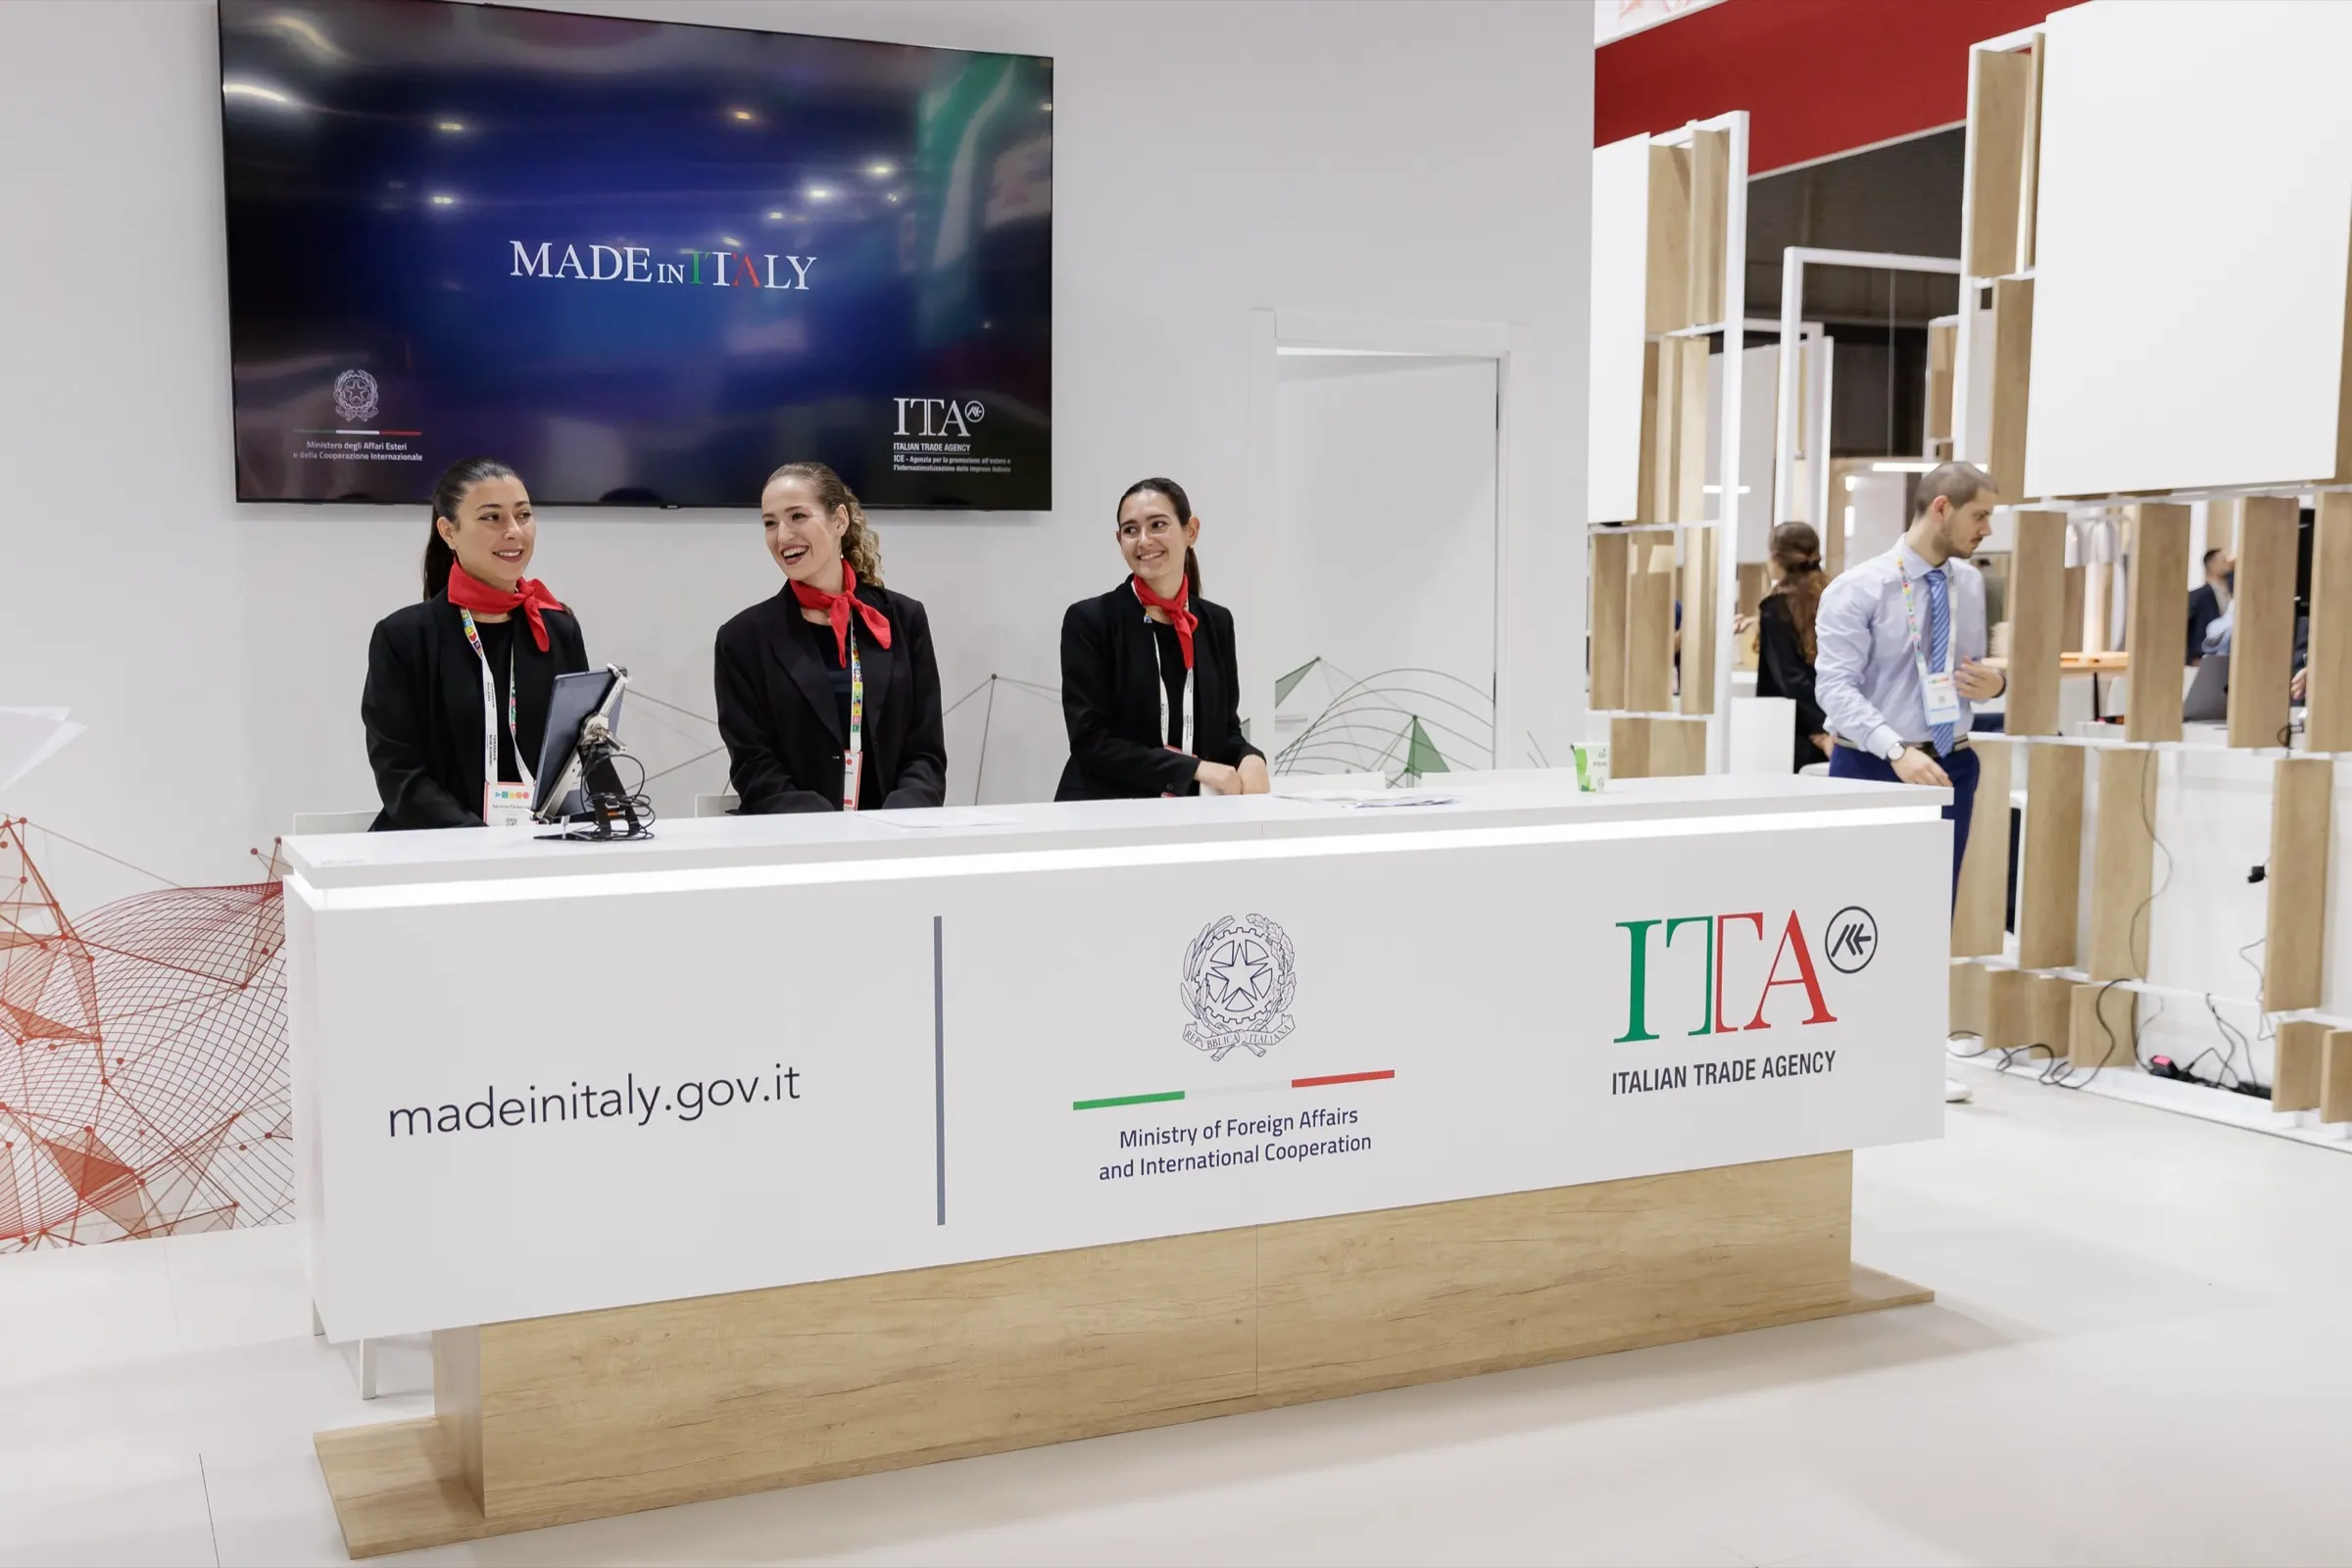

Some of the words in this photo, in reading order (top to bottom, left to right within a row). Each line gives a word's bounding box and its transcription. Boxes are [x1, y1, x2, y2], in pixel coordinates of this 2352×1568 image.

[510, 240, 653, 283] MADE
[658, 263, 685, 285] IN
[689, 250, 817, 291] ITALY
[893, 398, 971, 437] ITA
[307, 441, 343, 450] Ministero
[344, 442, 362, 452] degli
[364, 442, 384, 451] Affari
[318, 452, 369, 461] Cooperazione
[370, 453, 423, 462] Internazionale
[894, 442, 919, 451] ITALIAN
[921, 443, 943, 452] TRADE
[944, 444, 971, 453] AGENCY
[909, 456, 931, 465] Agenzia
[1613, 909, 1838, 1044] ITA
[1250, 1024, 1291, 1044] ITALIANA
[1612, 1065, 1687, 1095] ITALIAN
[1693, 1058, 1756, 1086] TRADE
[1761, 1050, 1837, 1079] AGENCY
[389, 1062, 801, 1138] madeinitaly.gov.it
[1119, 1125, 1198, 1149] Ministry
[1202, 1120, 1222, 1140] of
[1227, 1114, 1294, 1137] Foreign
[1299, 1107, 1358, 1129] Affairs
[1099, 1158, 1134, 1181] and
[1141, 1145, 1259, 1176] International
[1265, 1135, 1372, 1162] Cooperation
